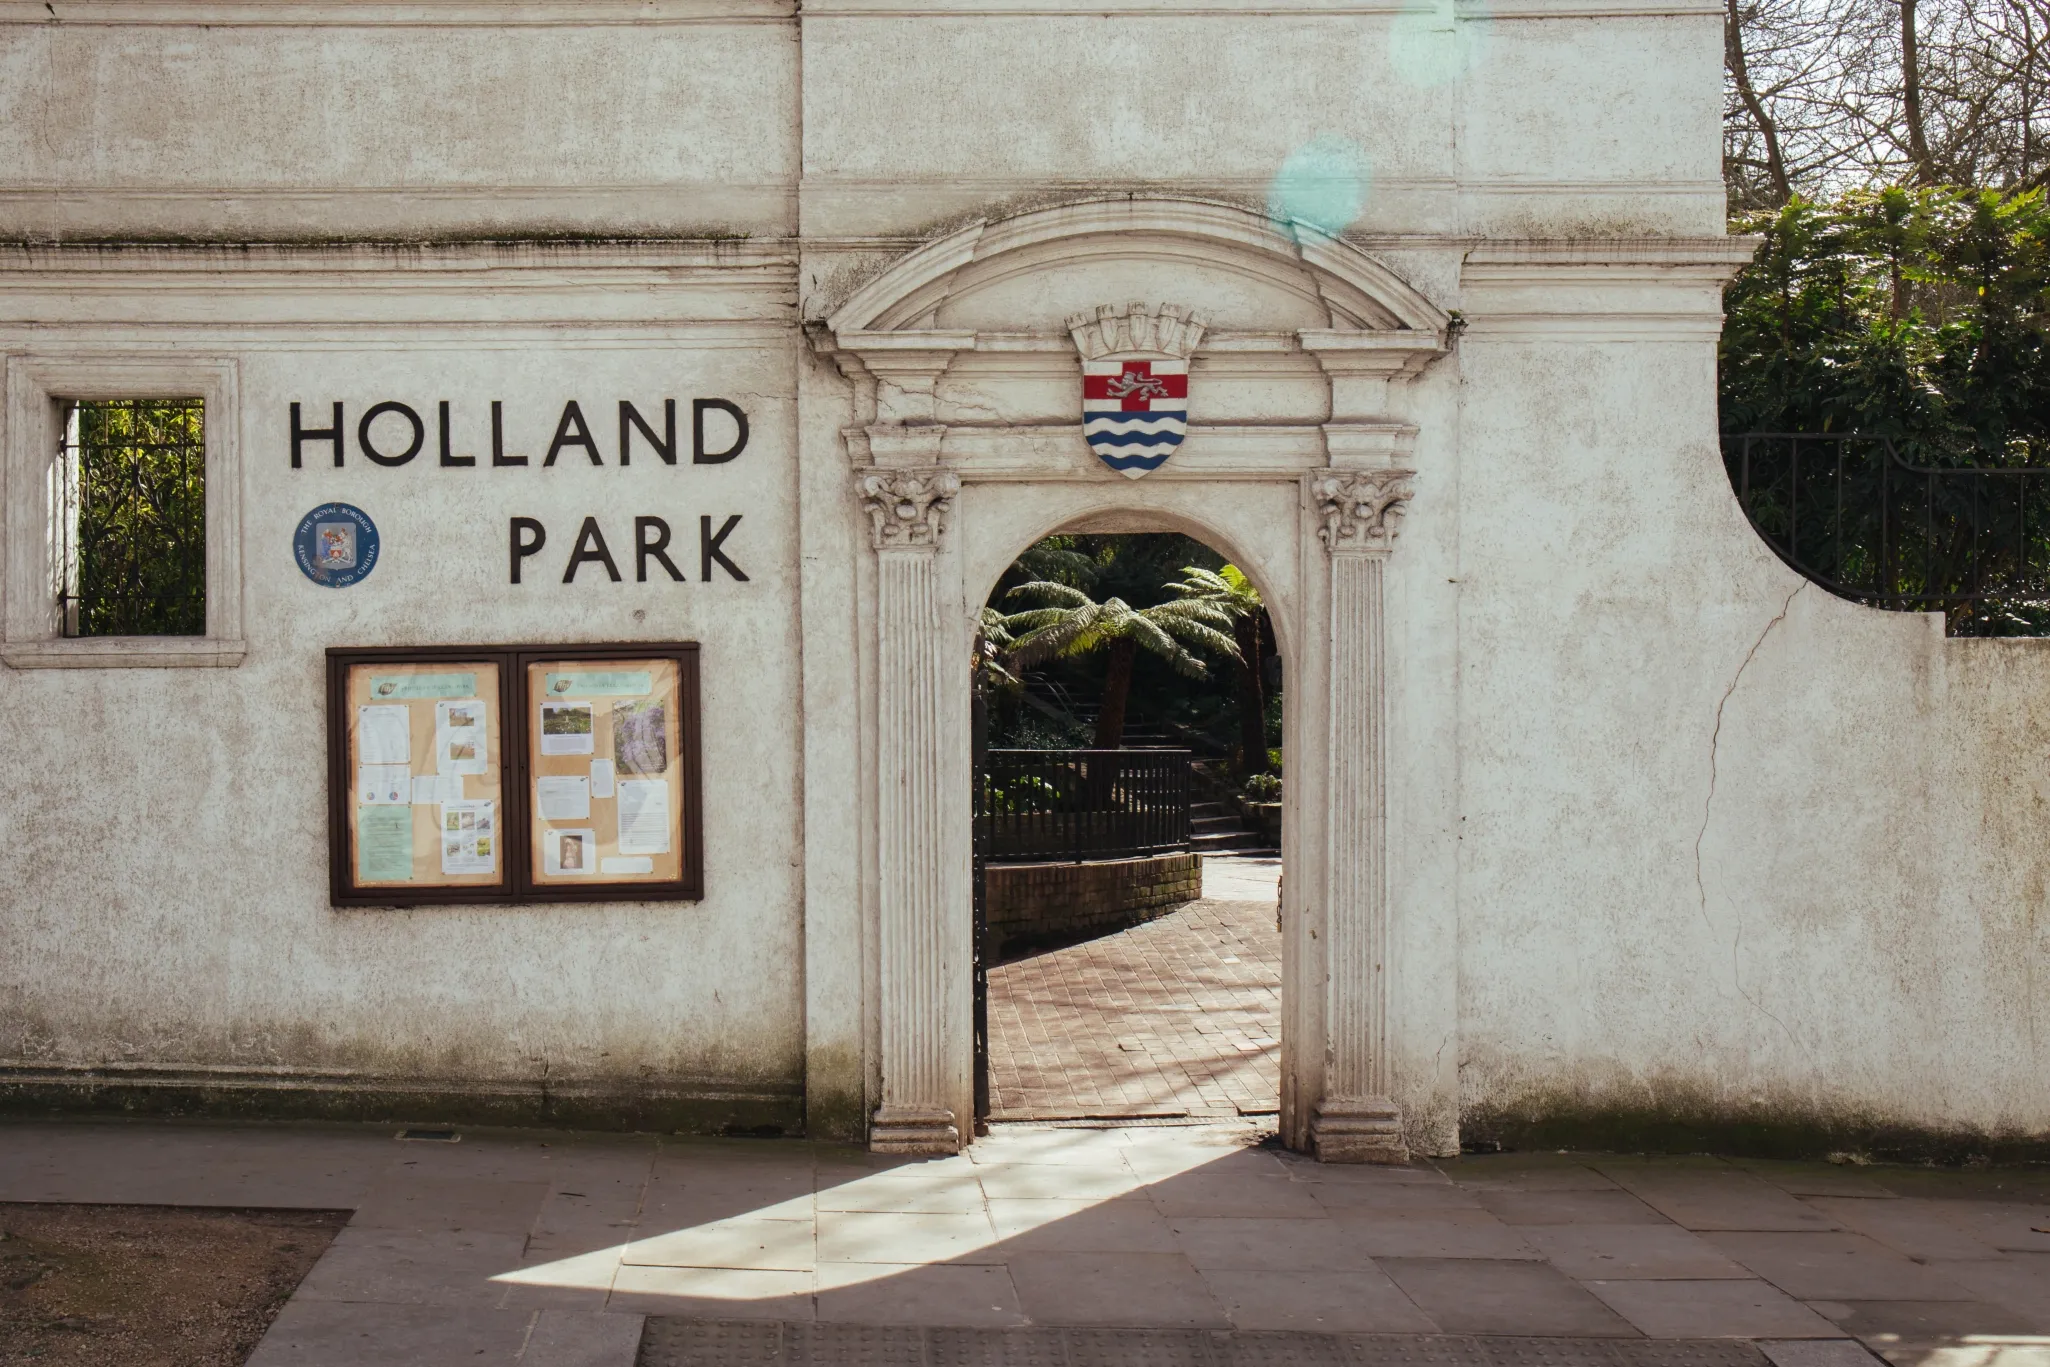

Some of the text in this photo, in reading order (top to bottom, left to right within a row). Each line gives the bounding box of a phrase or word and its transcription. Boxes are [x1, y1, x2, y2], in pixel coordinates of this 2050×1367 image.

[290, 398, 750, 468] HOLLAND
[301, 508, 372, 533] THE ROYAL BOROUGH
[510, 515, 750, 584] PARK
[337, 575, 353, 583] AND
